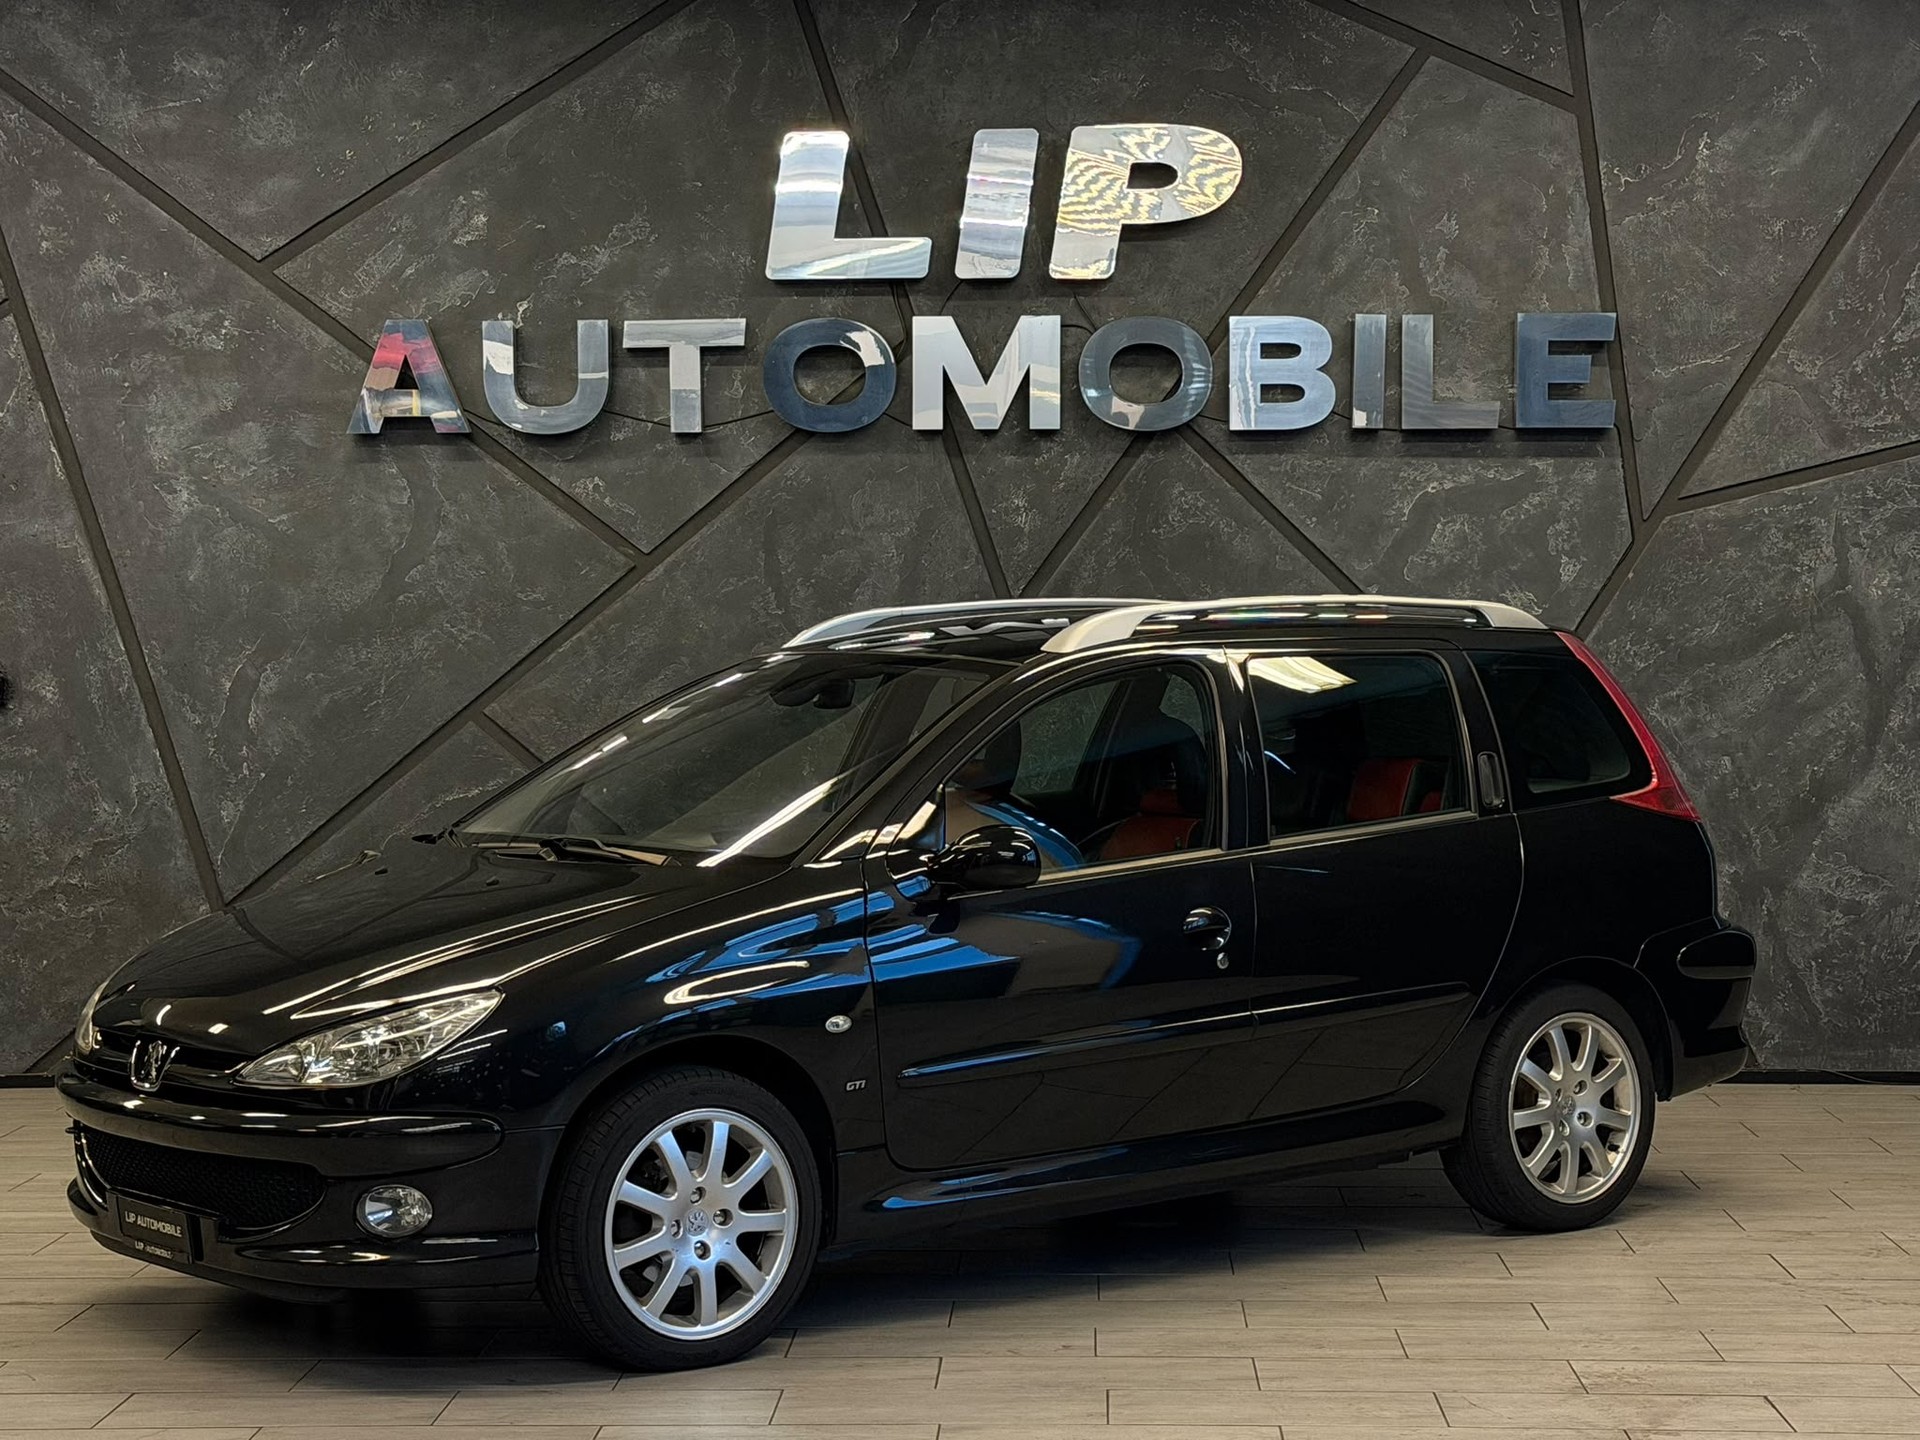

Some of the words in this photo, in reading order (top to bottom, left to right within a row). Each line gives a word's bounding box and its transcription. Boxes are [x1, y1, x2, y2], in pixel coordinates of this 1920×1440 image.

[766, 123, 1243, 280] LIP
[346, 312, 1618, 435] AUTOMOBILE
[125, 1211, 136, 1223] LIP
[137, 1215, 182, 1237] AUTOMOBILE
